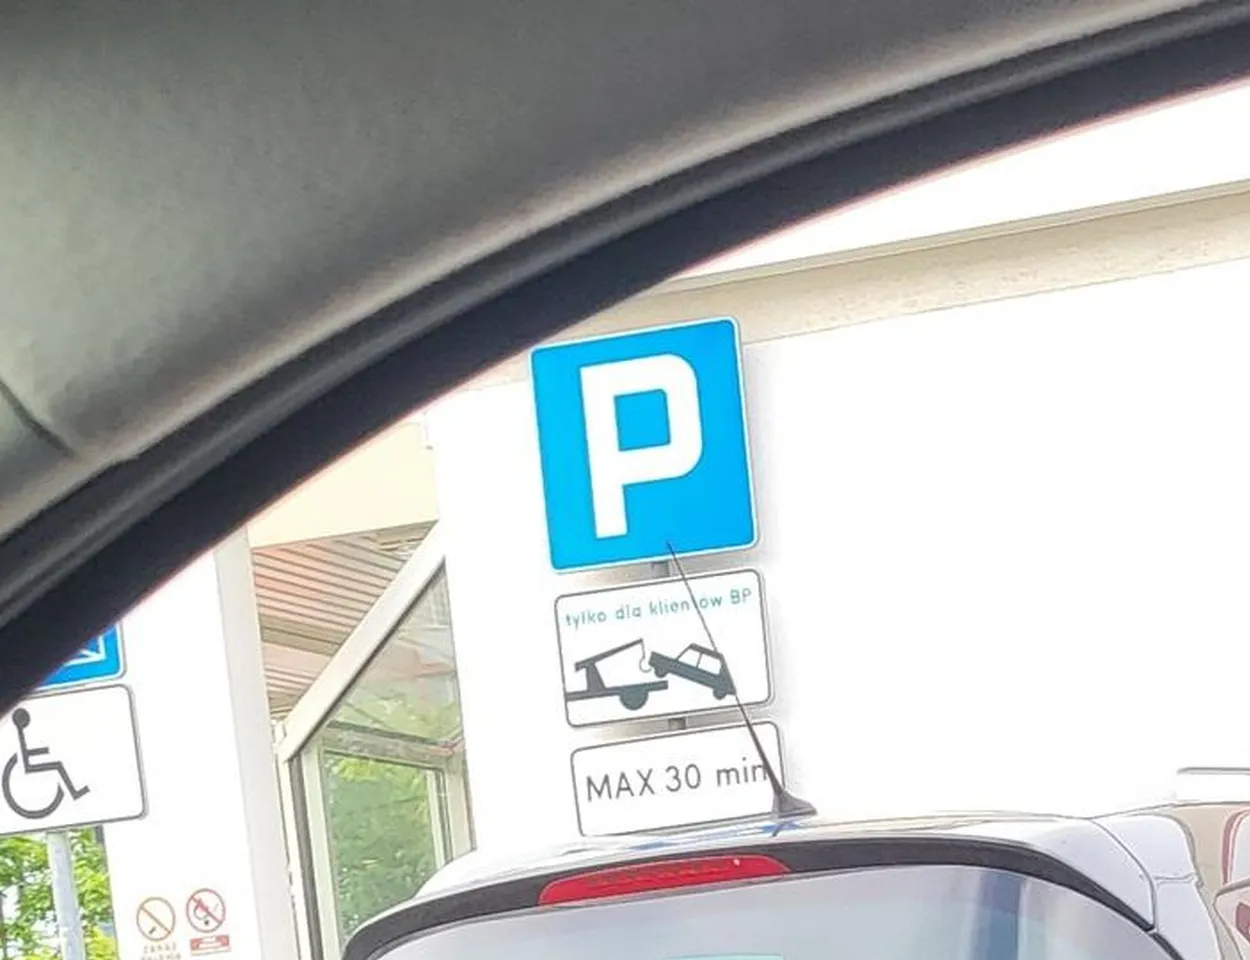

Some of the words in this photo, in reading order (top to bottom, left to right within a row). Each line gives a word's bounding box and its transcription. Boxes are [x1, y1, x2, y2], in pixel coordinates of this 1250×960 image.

[579, 352, 704, 540] P
[565, 611, 608, 630] tylko
[615, 604, 642, 620] dla
[729, 587, 753, 605] BP
[586, 767, 656, 803] MAX
[665, 763, 702, 793] 30
[716, 756, 768, 787] min
